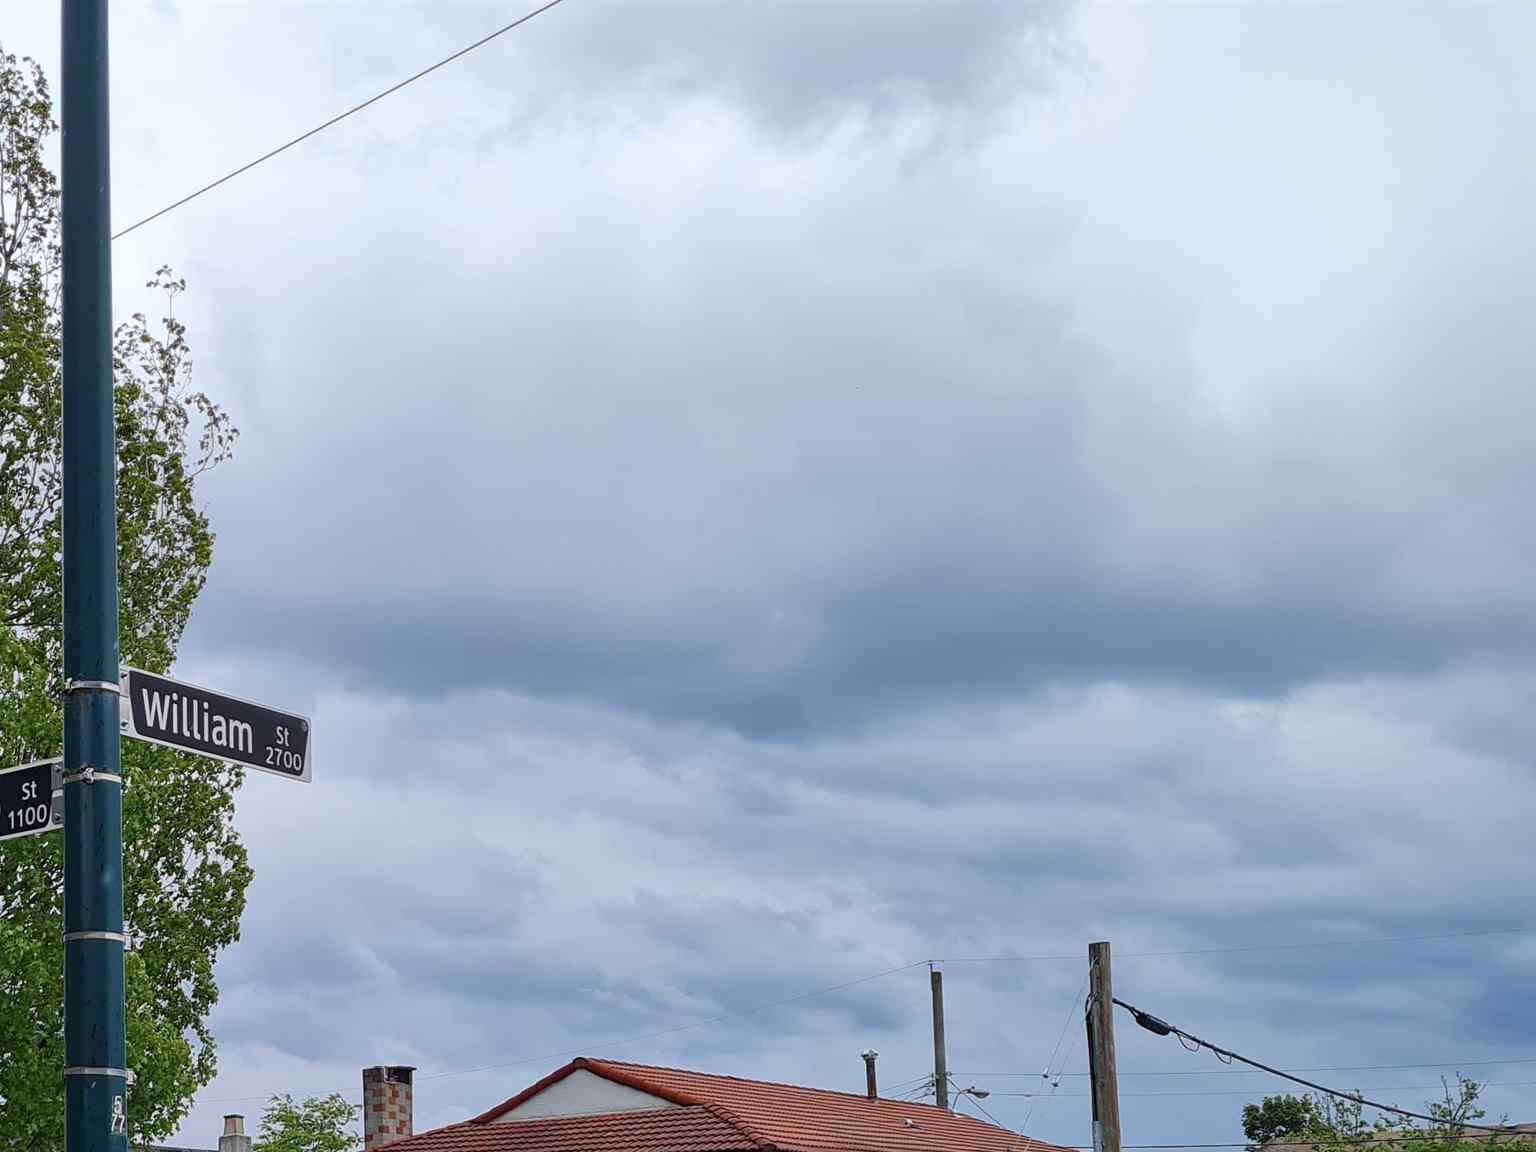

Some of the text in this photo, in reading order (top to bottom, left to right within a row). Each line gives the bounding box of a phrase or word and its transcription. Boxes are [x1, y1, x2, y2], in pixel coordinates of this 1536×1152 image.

[142, 687, 290, 753] William St
[266, 746, 302, 771] 2700
[21, 780, 37, 800] St
[7, 804, 48, 829] 1100
